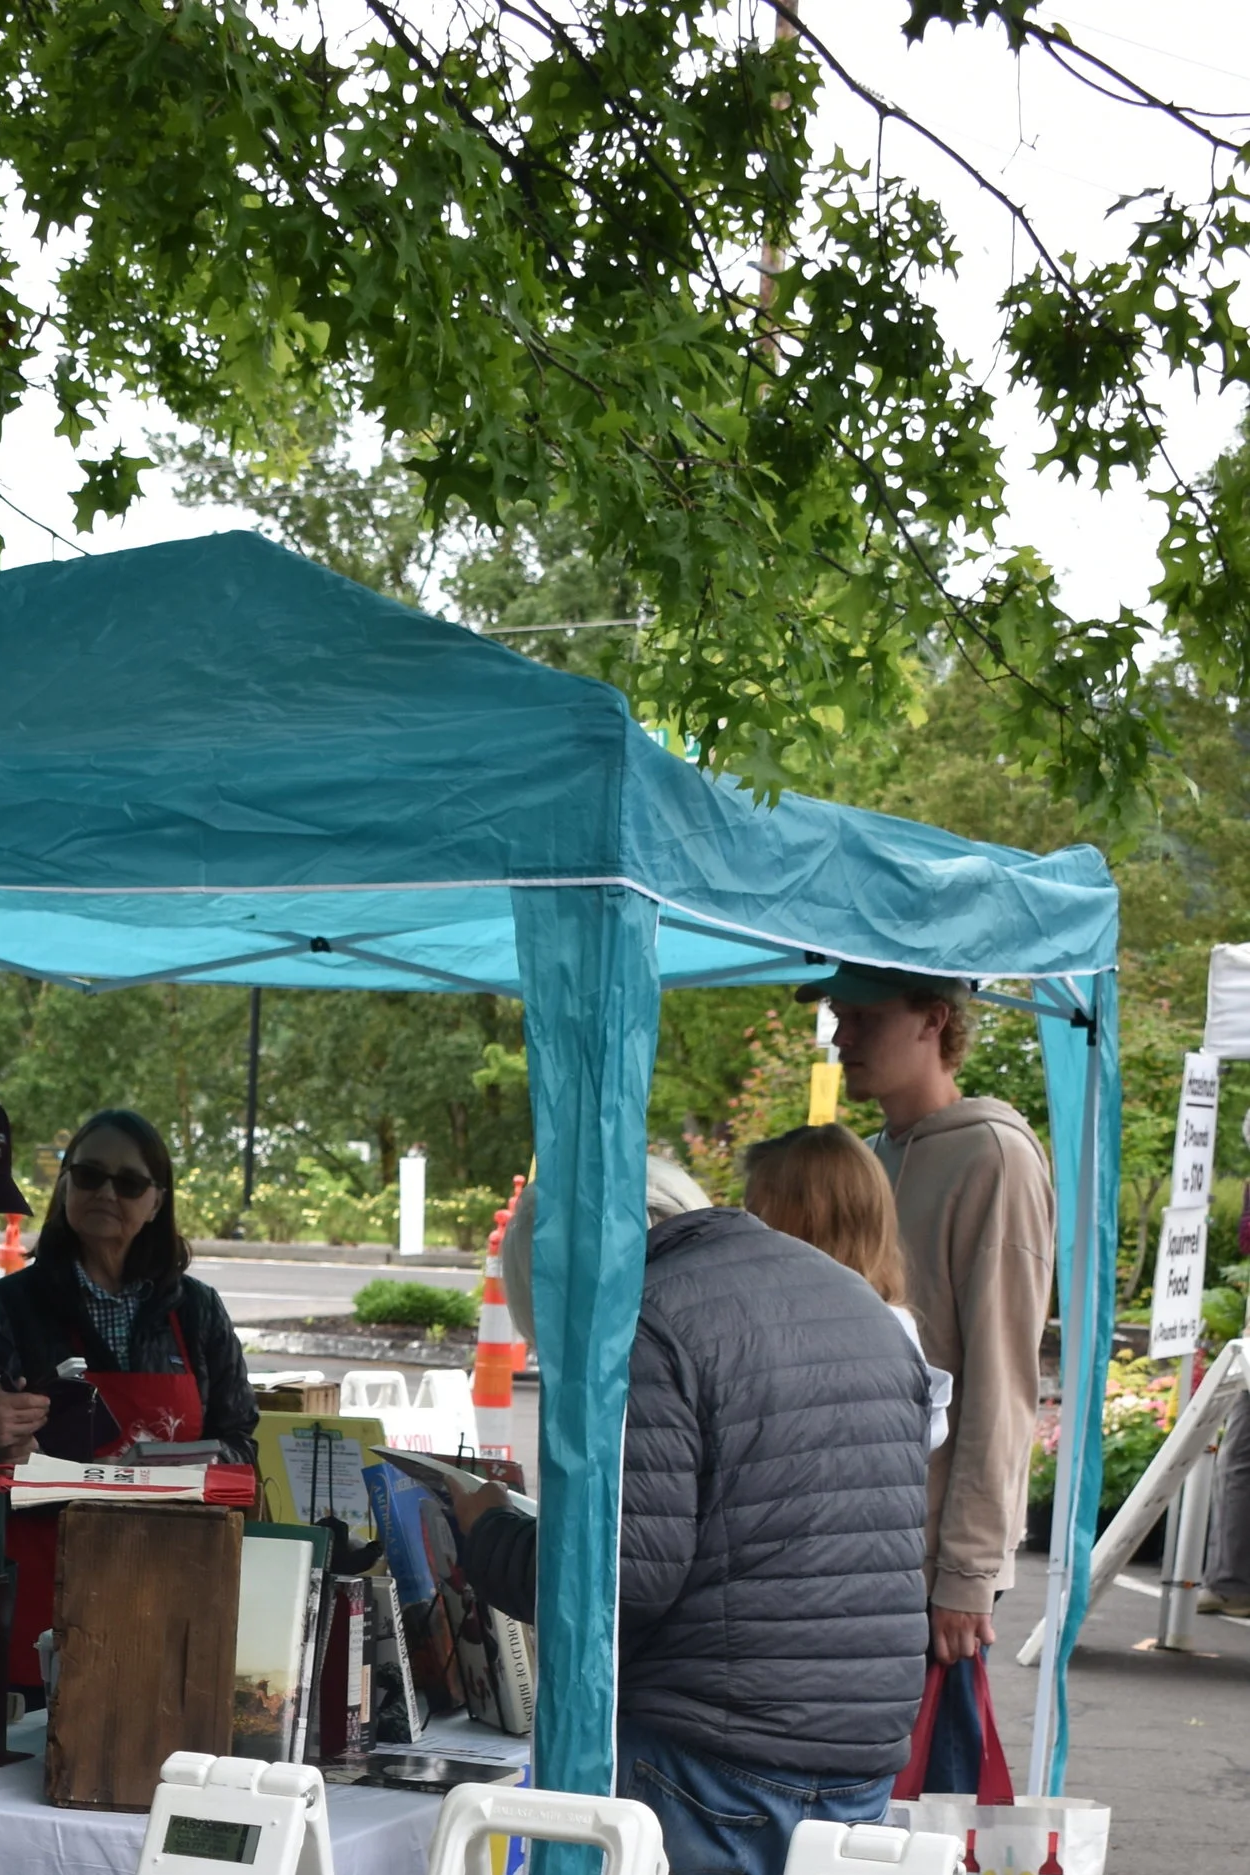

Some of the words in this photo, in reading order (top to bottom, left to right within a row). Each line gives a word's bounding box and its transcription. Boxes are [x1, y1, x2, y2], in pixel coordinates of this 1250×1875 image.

[1166, 1224, 1201, 1262] Squirrel
[1166, 1265, 1191, 1299] Food
[518, 1682, 534, 1727] BIRDS
